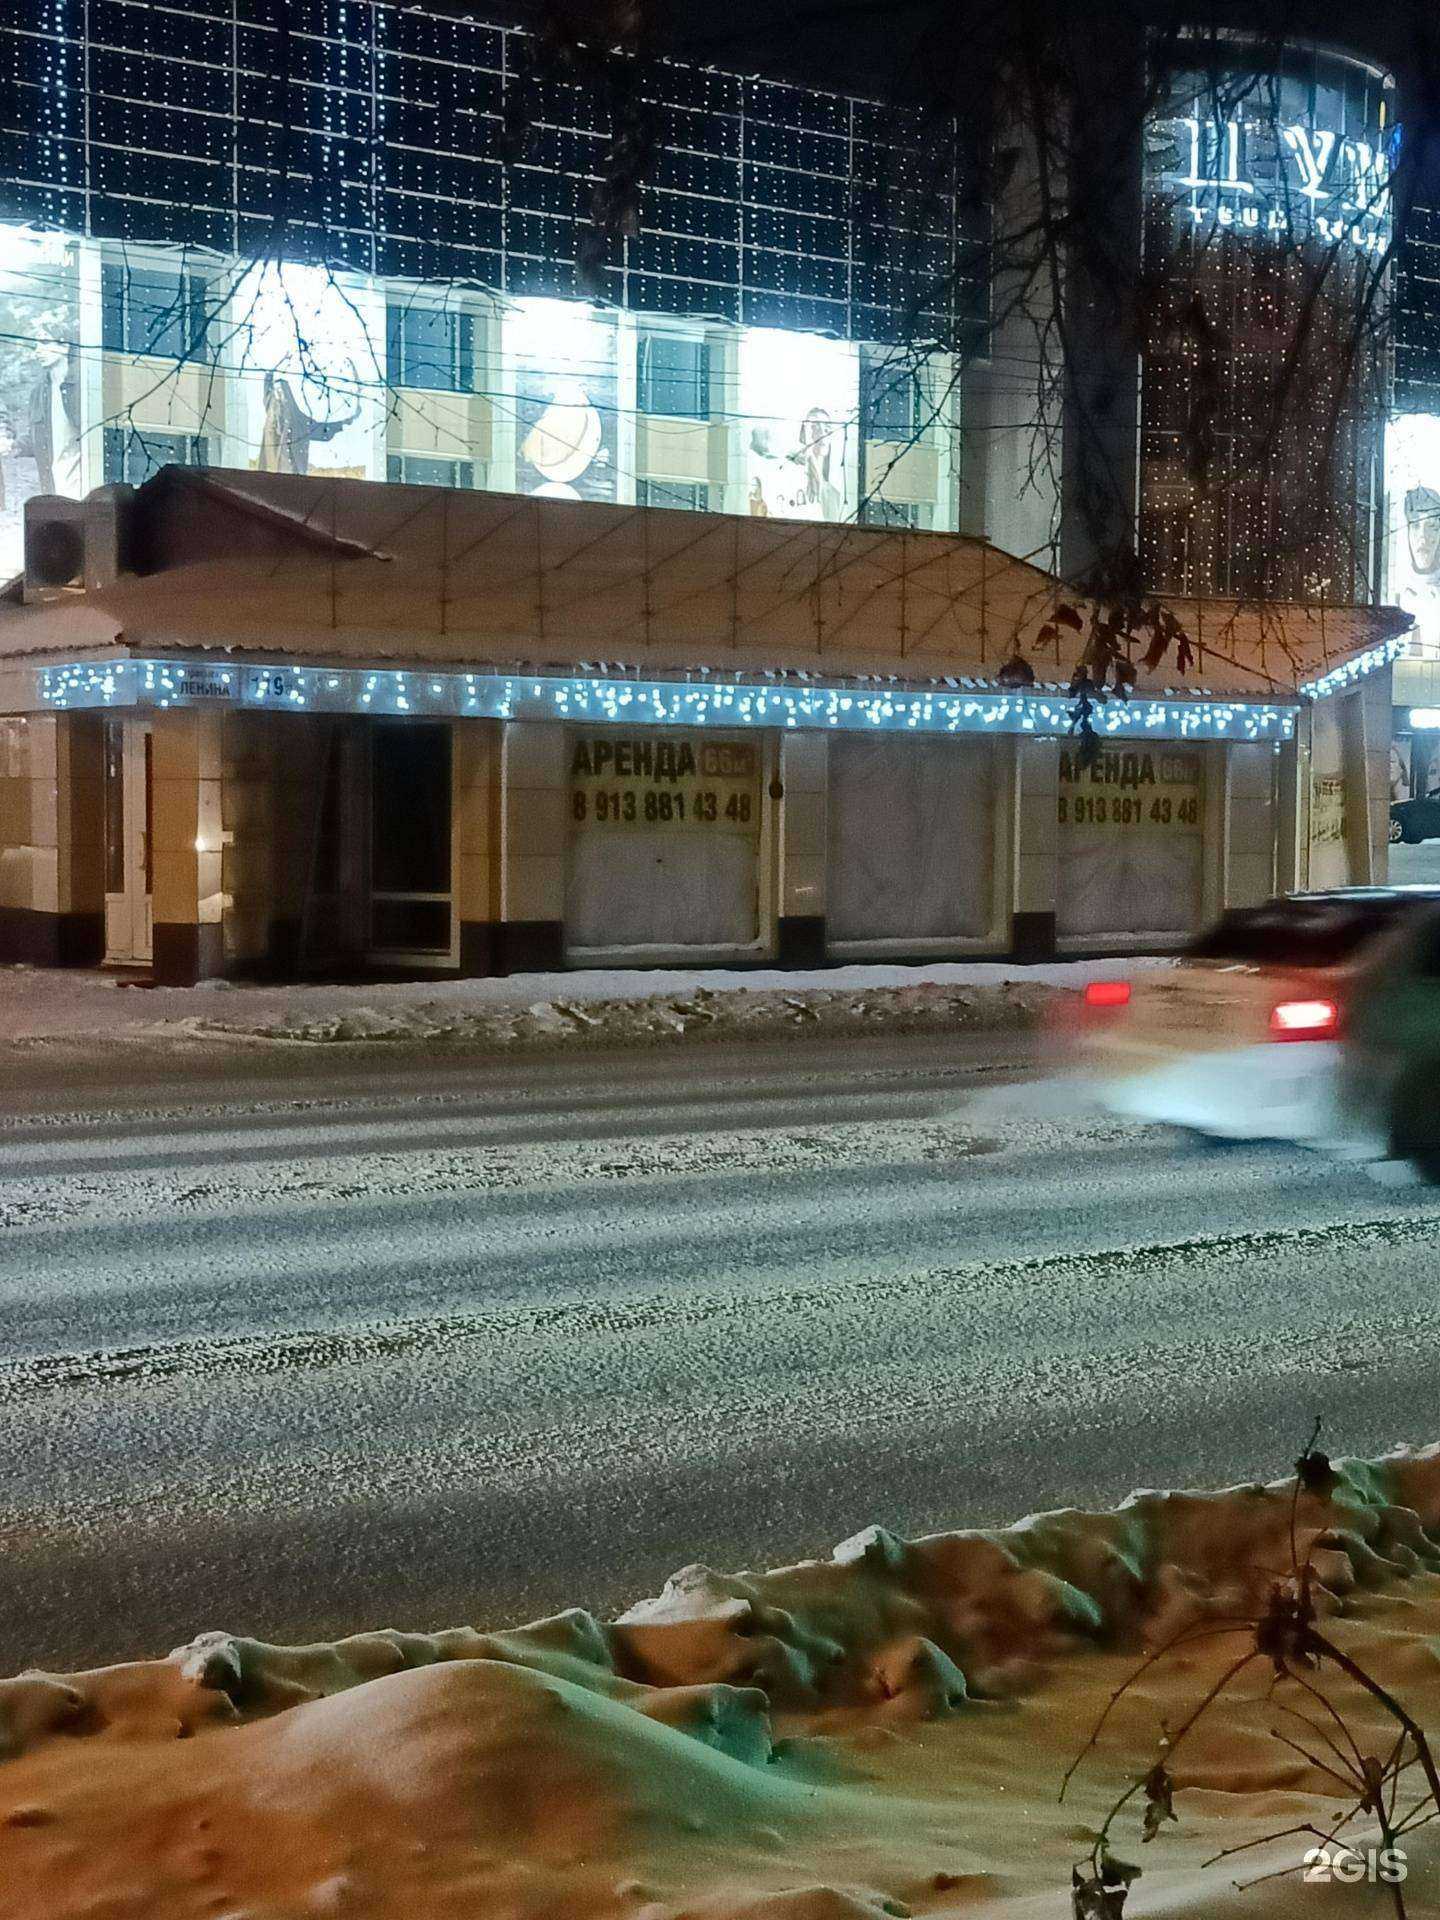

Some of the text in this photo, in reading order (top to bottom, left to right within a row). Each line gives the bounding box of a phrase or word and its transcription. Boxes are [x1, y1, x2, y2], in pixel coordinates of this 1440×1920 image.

[179, 681, 231, 696] ЛЕНИНА
[571, 740, 697, 783] АРЕНДА
[572, 790, 752, 823] 8 913 881 43 48
[1074, 796, 1107, 824] 913
[1112, 796, 1142, 824] 881
[1149, 797, 1172, 824] 43
[1178, 797, 1198, 824] 48
